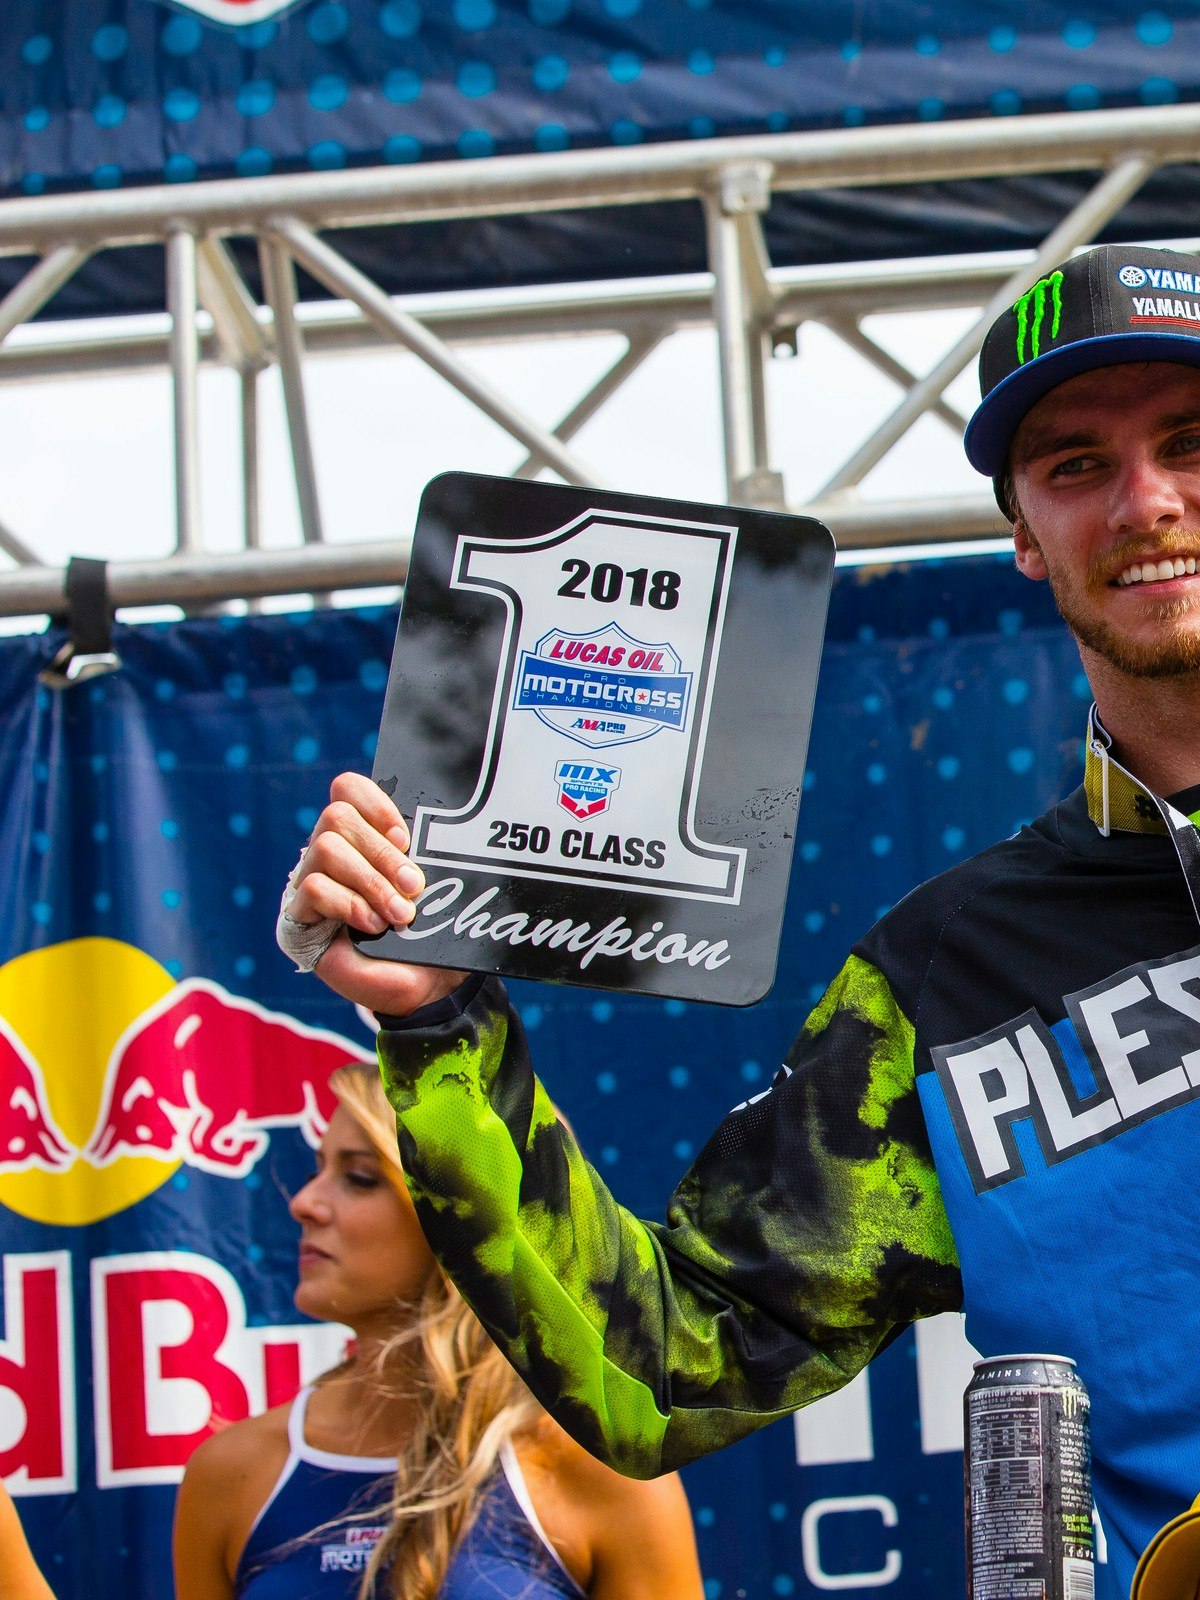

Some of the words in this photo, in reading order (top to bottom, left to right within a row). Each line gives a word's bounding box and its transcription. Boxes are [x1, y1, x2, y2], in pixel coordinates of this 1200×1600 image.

[557, 558, 682, 611] 2018
[549, 639, 626, 667] LUCAS
[627, 649, 665, 672] OIL
[523, 673, 682, 710] MOTOCROSS
[583, 673, 627, 684] PRO
[522, 691, 681, 716] CHAMPIONSHIP
[569, 717, 606, 732] AMA
[606, 722, 626, 731] PRO
[565, 783, 579, 792] PRO
[580, 785, 606, 795] RACING
[486, 820, 551, 854] 250
[559, 828, 667, 870] CLASS
[394, 877, 732, 971] Champion
